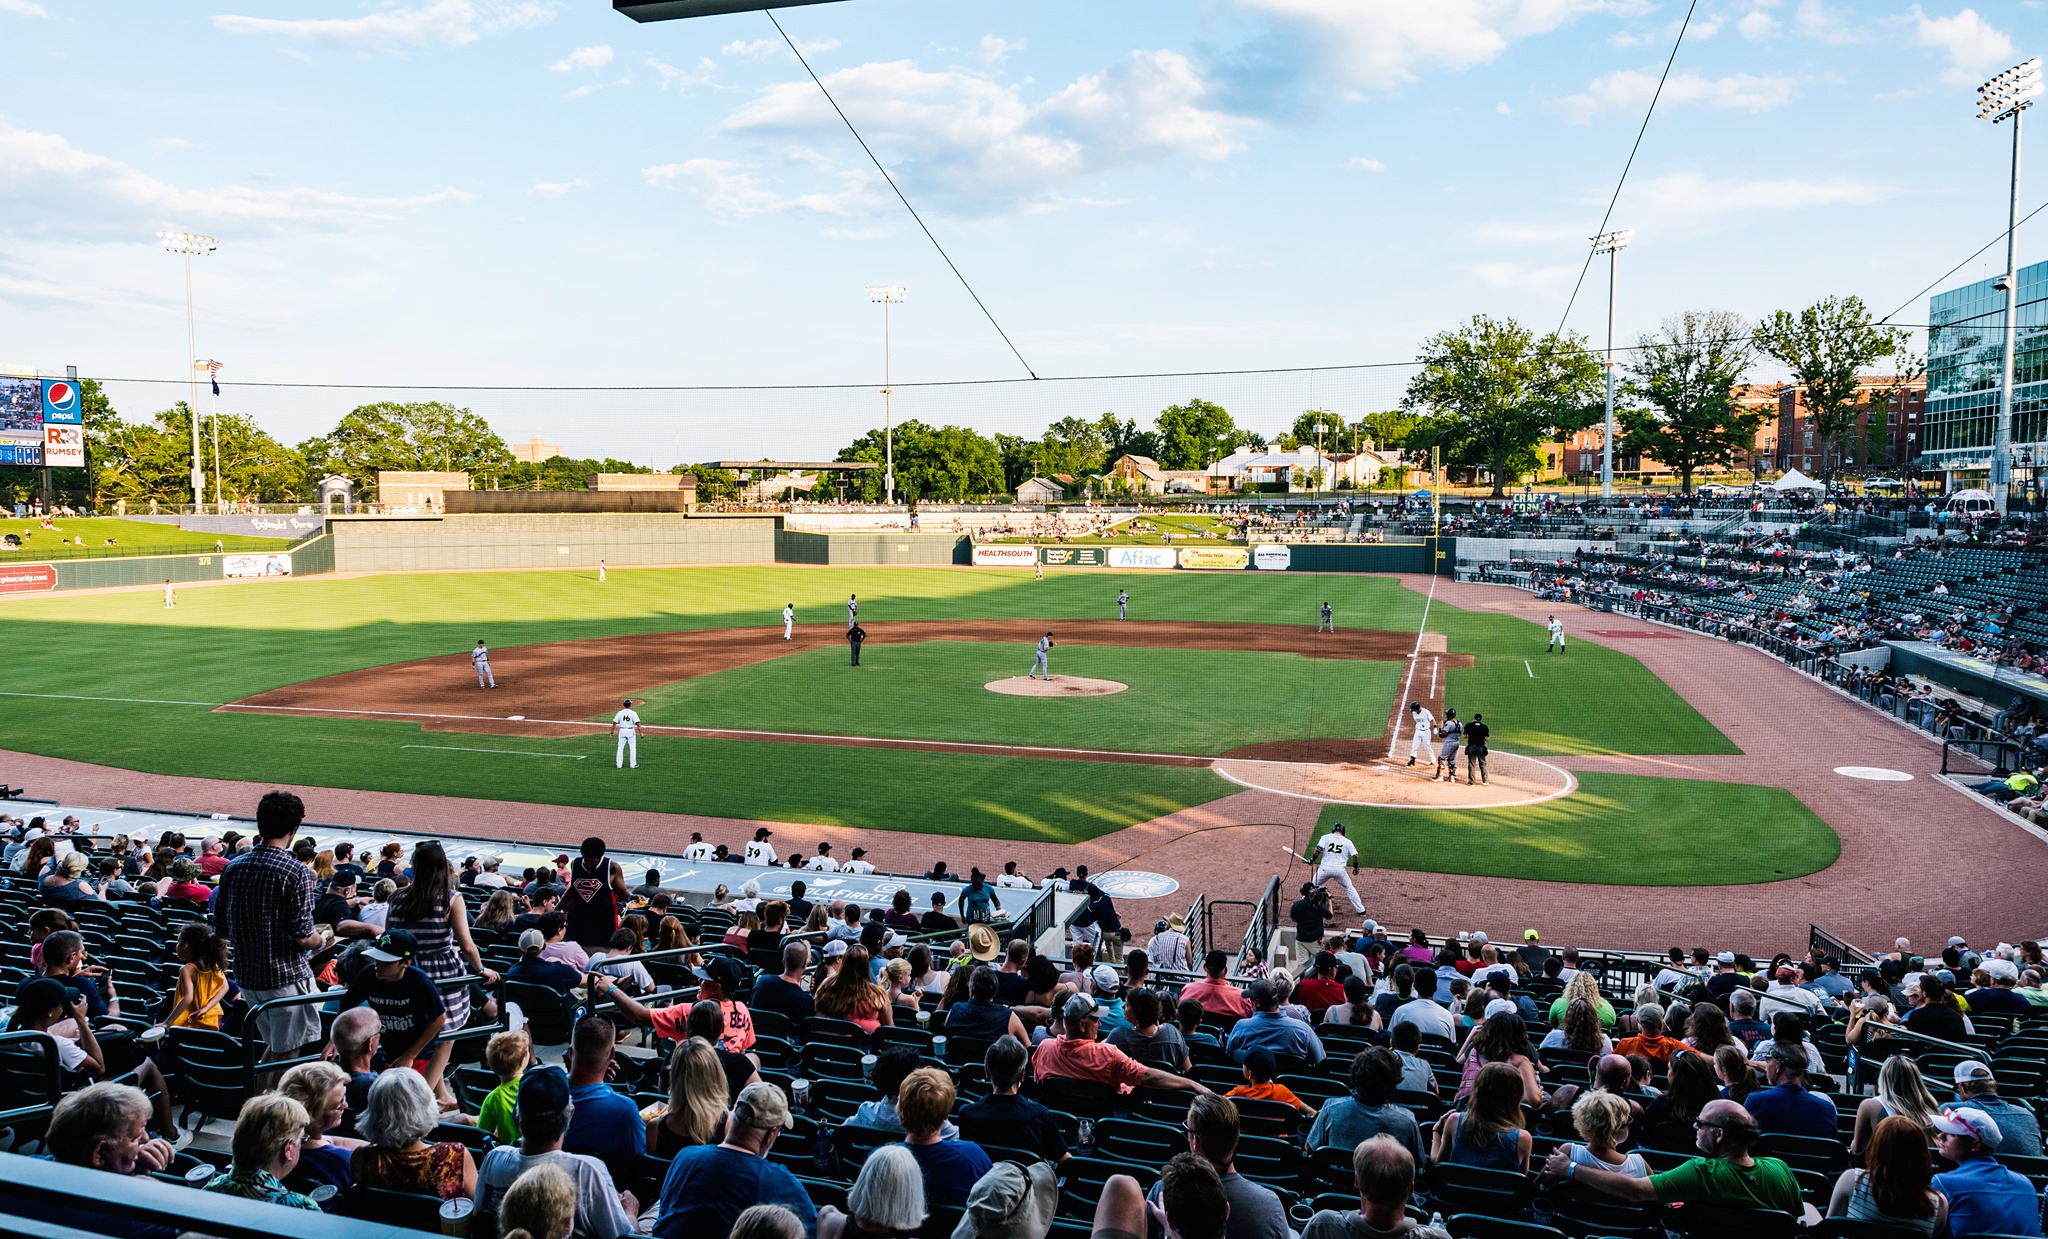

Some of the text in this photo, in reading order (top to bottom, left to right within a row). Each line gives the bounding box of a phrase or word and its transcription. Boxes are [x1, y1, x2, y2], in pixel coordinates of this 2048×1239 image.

[52, 412, 74, 420] pepsi
[1513, 493, 1545, 503] CRAFT
[198, 556, 211, 565] 372
[1120, 550, 1161, 565] Aflac
[747, 846, 761, 859] 39
[1327, 842, 1344, 854] 25
[394, 998, 410, 1006] PLAY
